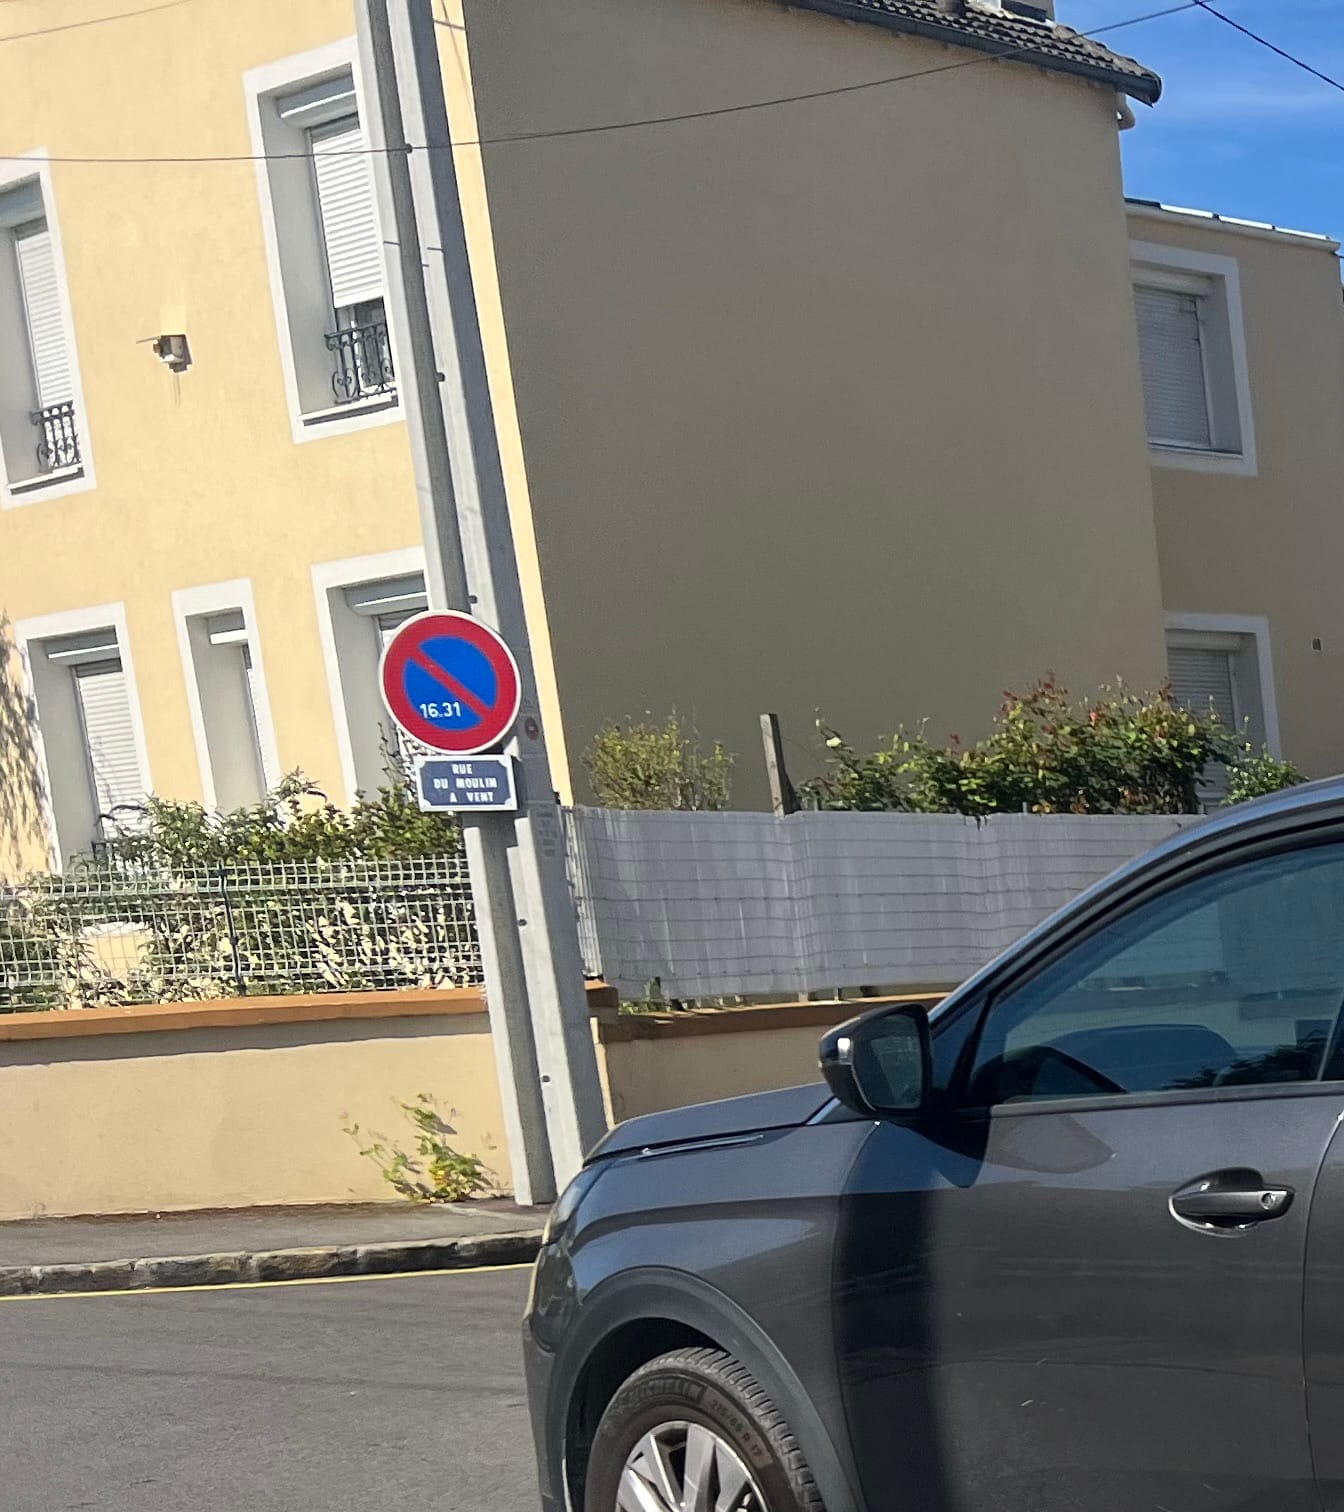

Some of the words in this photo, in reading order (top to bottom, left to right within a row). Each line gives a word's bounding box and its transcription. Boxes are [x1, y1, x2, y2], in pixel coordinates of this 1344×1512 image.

[419, 701, 462, 719] 16.31
[452, 763, 473, 775] RUE
[433, 778, 449, 789] DU
[456, 777, 498, 789] MOULIN
[450, 792, 457, 802] A
[466, 792, 494, 803] VENT
